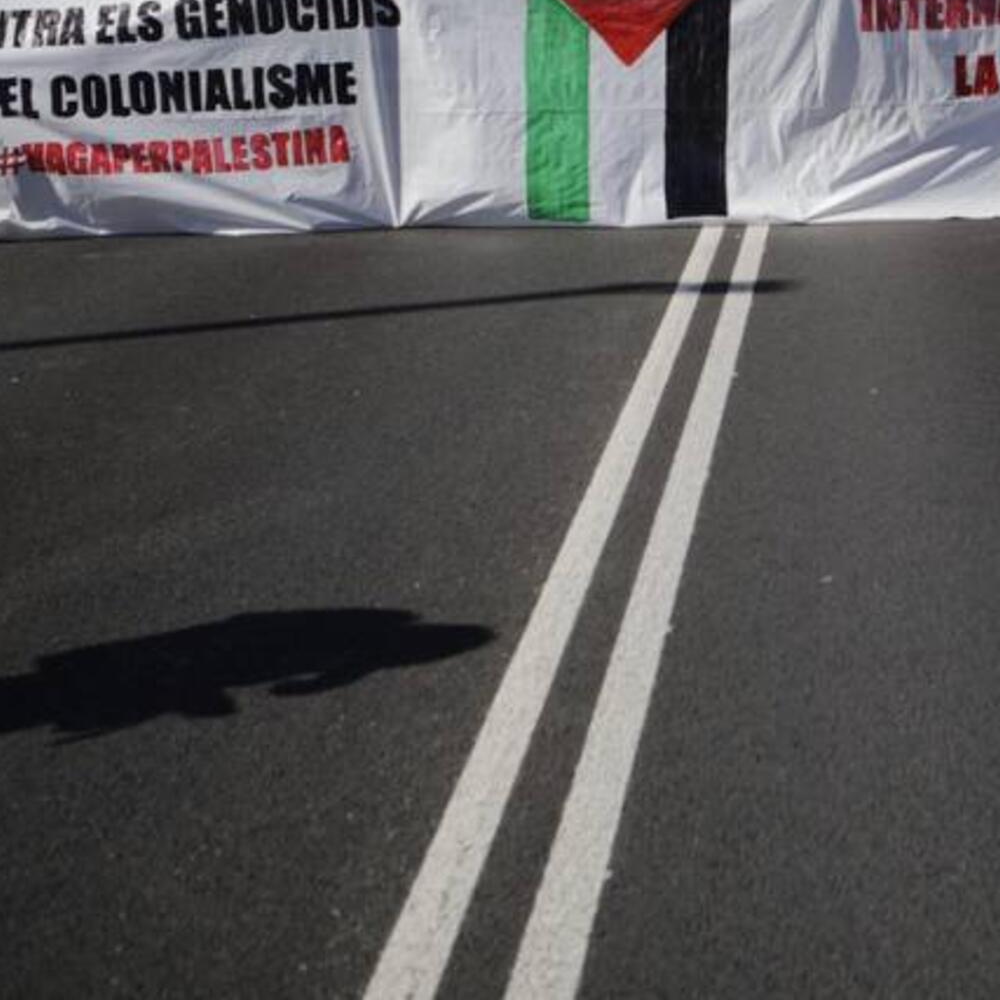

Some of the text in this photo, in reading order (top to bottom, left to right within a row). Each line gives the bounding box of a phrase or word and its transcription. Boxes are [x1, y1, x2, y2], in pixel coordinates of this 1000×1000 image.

[96, 1, 164, 45] ELS
[50, 62, 357, 119] COLONIALISME
[954, 54, 999, 98] LA
